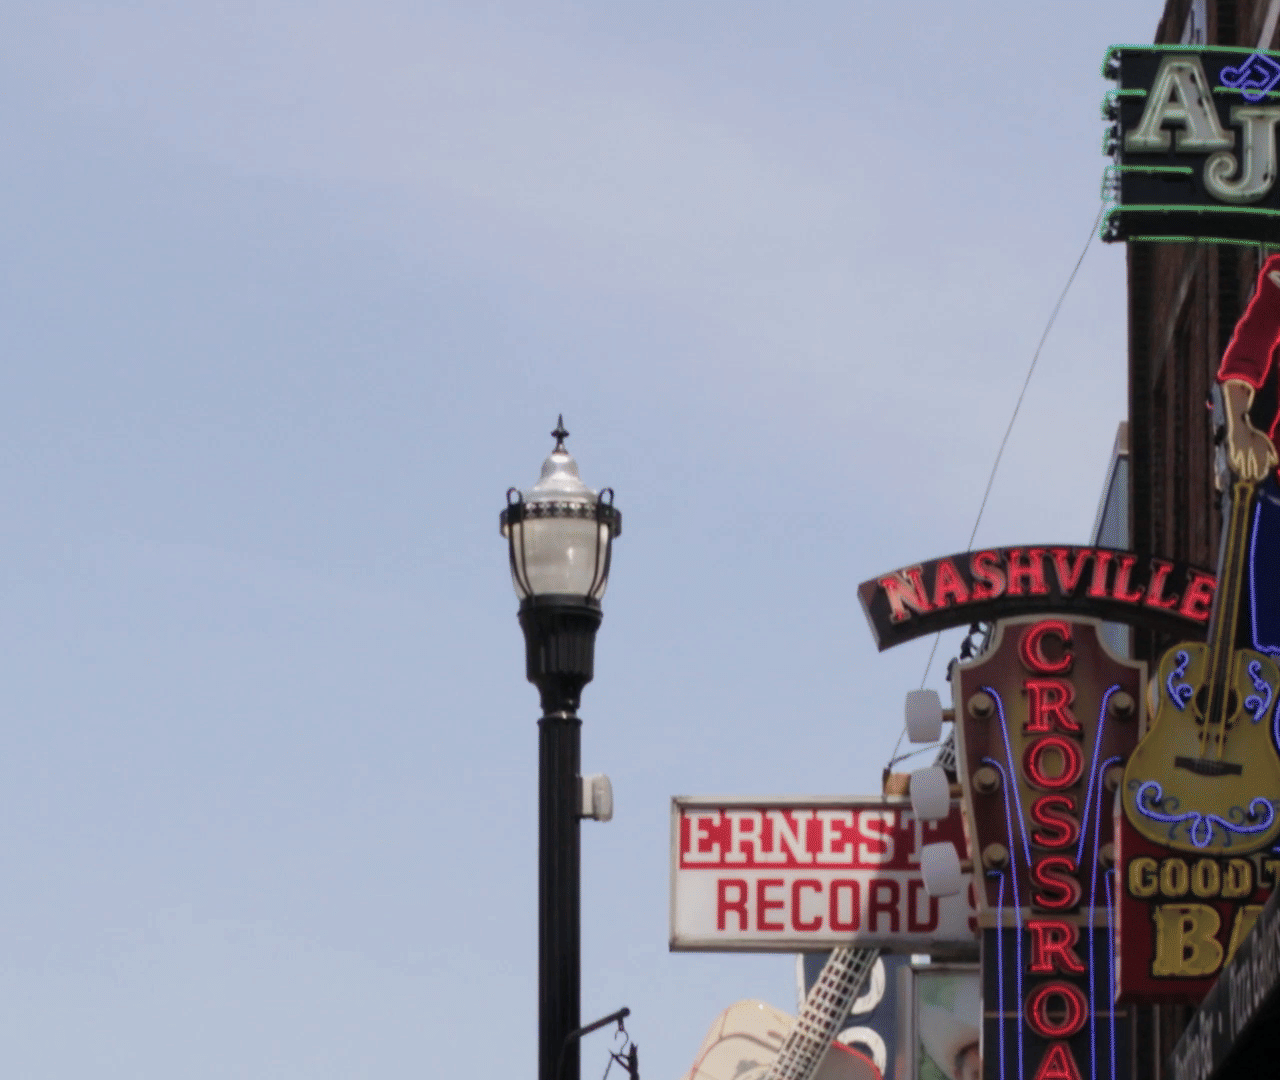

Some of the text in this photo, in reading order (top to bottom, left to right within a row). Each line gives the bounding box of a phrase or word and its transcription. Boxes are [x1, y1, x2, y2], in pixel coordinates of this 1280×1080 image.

[878, 547, 1218, 624] NASHVILLE
[683, 810, 940, 863] ERNEST
[1129, 857, 1253, 898] GOOD
[716, 878, 939, 933] RECORD
